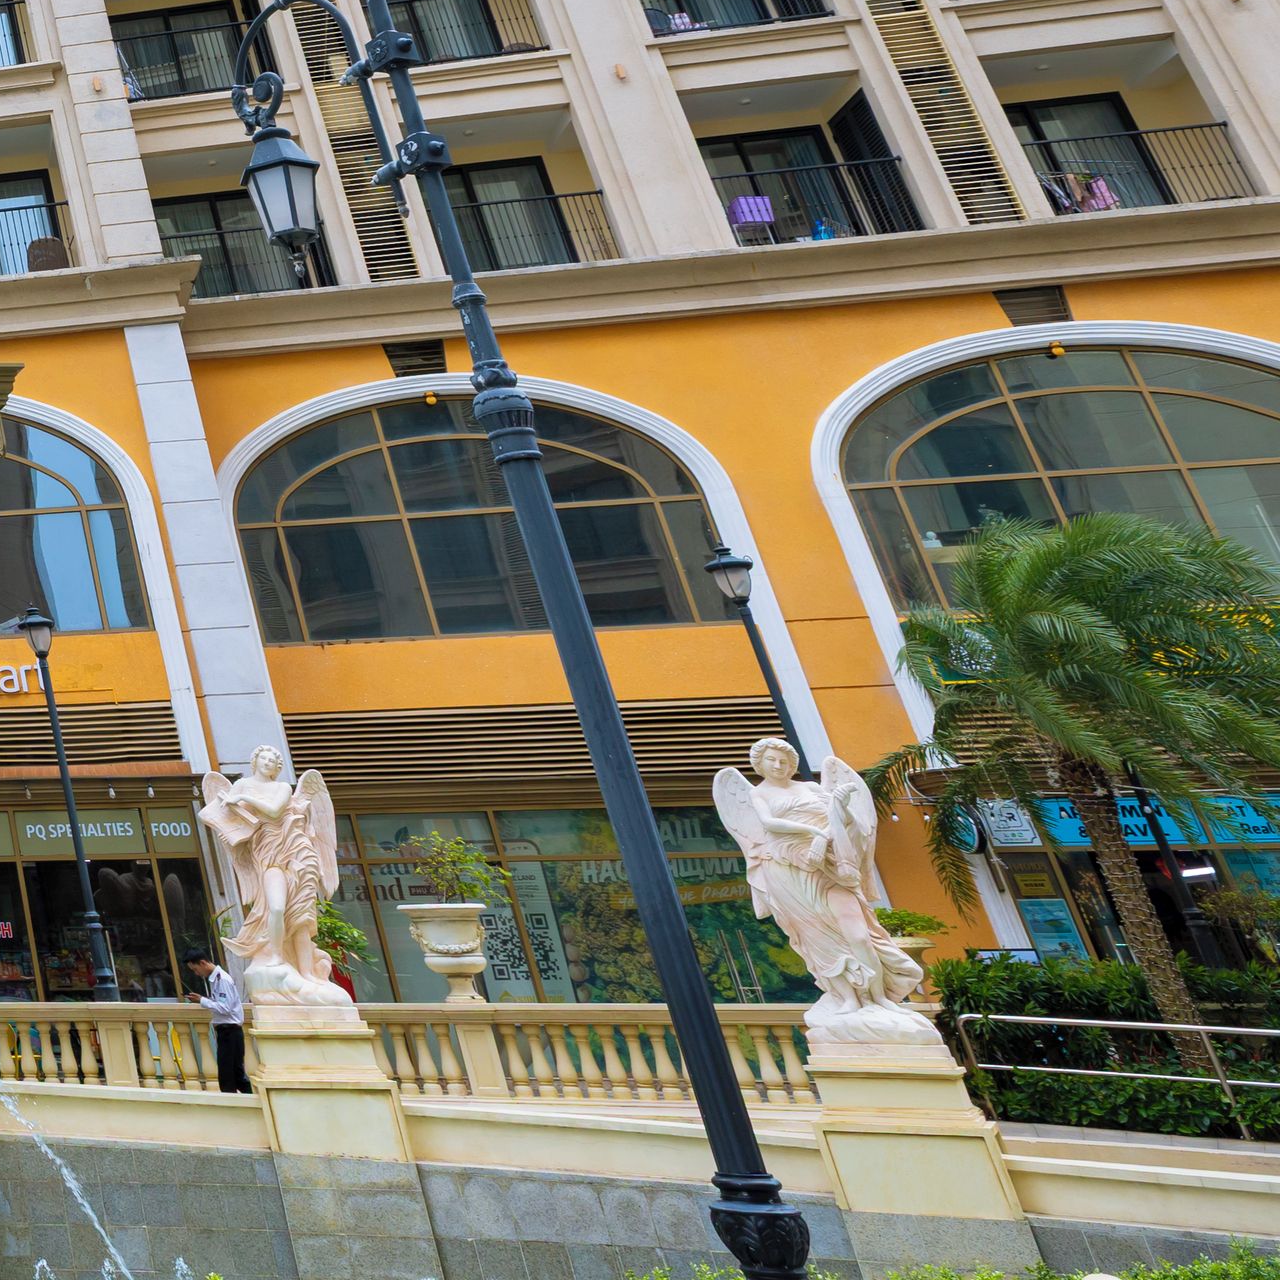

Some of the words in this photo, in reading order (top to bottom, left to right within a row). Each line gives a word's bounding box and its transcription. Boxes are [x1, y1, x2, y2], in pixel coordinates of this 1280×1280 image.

[26, 825, 46, 840] PQ
[49, 822, 134, 839] SPEIALTIES
[151, 822, 191, 837] FOOD
[339, 877, 406, 902] Land
